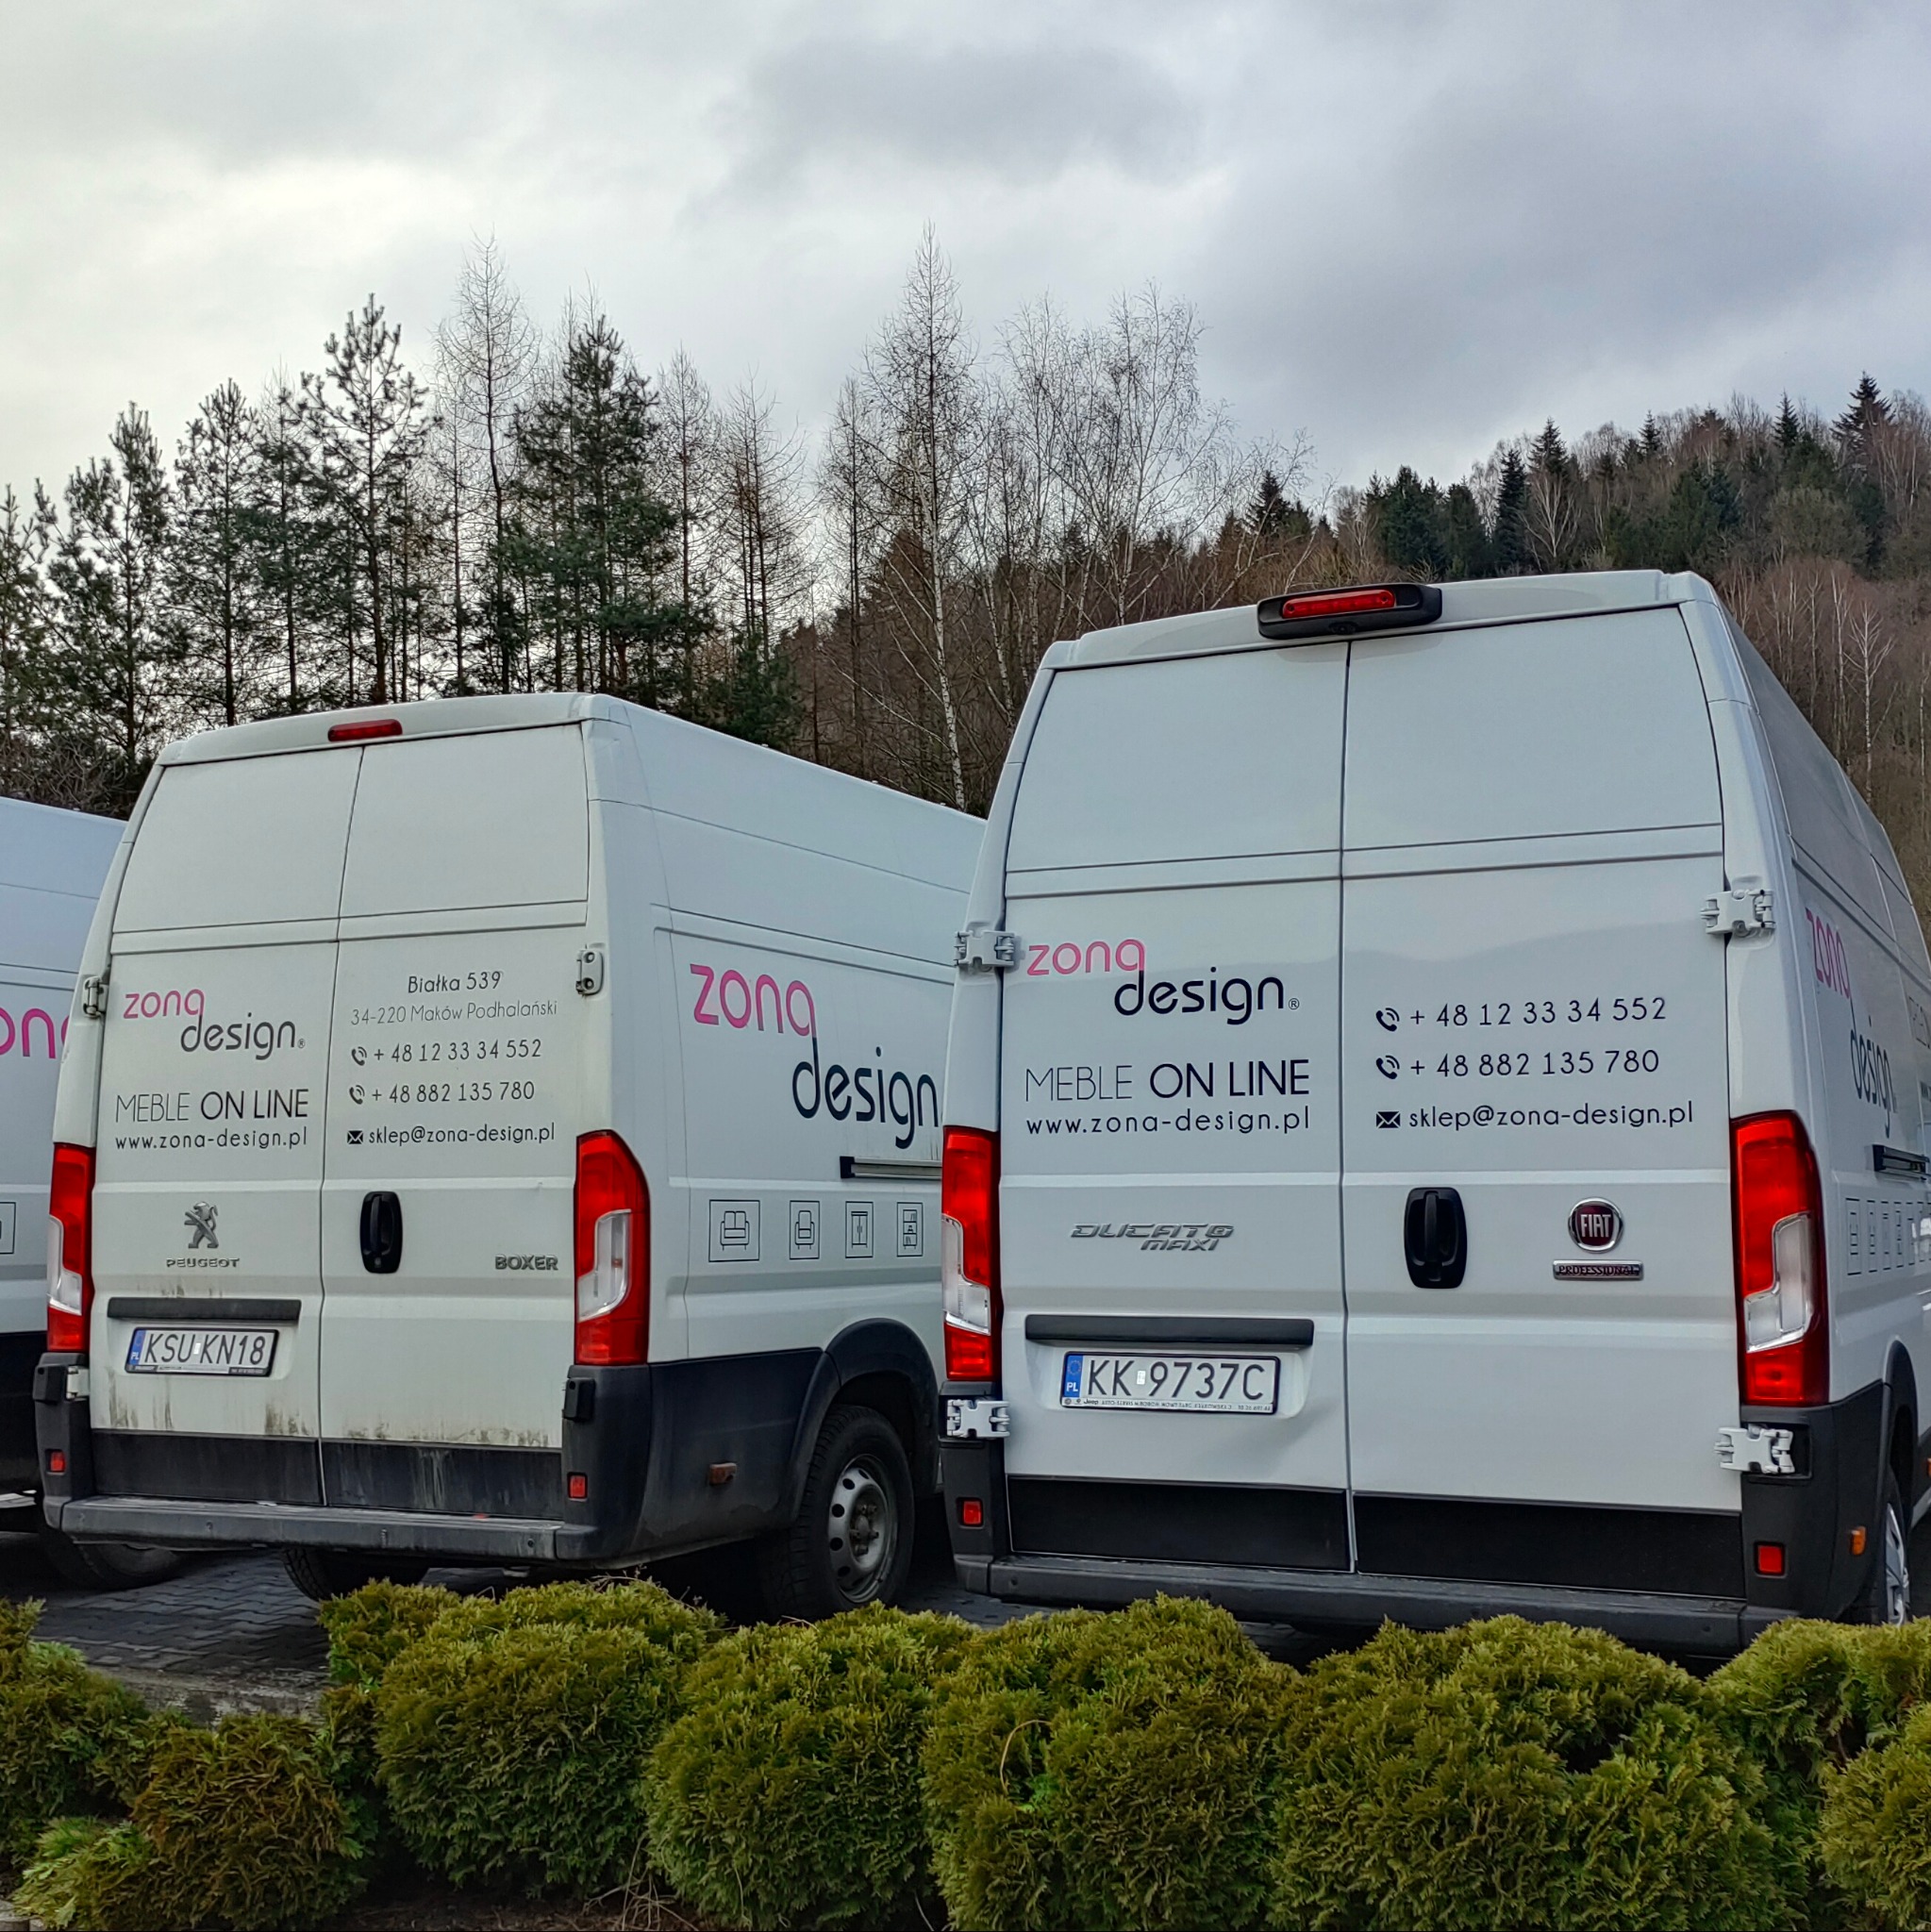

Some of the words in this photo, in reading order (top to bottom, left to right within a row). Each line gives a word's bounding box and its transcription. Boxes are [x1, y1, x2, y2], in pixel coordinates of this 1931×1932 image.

[408, 974, 460, 993] Białka
[466, 971, 501, 990] 539
[350, 1006, 407, 1025] 34-220
[410, 1005, 463, 1022] Maków
[467, 999, 558, 1019] Podhalański
[1437, 1003, 1468, 1027] 48
[1479, 1003, 1510, 1025] 12
[1523, 1001, 1556, 1024] 33
[1567, 997, 1601, 1023] 34
[1612, 996, 1666, 1021] 552
[391, 1042, 412, 1063] 48
[419, 1042, 441, 1061] 12
[447, 1041, 470, 1060] 33
[476, 1040, 499, 1059] 34
[506, 1039, 541, 1058] 552
[1437, 1054, 1469, 1077] 48
[1478, 1053, 1530, 1076] 882
[1542, 1052, 1594, 1074] 135
[1605, 1049, 1659, 1073] 780
[389, 1084, 410, 1104] 48
[416, 1084, 451, 1103] 882
[458, 1082, 492, 1102] 135
[499, 1081, 535, 1100] 780
[1025, 1065, 1132, 1102] MEBLE
[1149, 1062, 1213, 1098] ON
[1229, 1059, 1309, 1096] LINE
[791, 1038, 939, 1149] design
[115, 1092, 191, 1123] MEBLE
[200, 1091, 244, 1120] ON
[254, 1089, 308, 1119] LINE
[1409, 1100, 1692, 1131] sklep@zona-design.pl
[1026, 1105, 1309, 1134] www.zona-design.pl
[115, 1126, 307, 1150] www.zona-design.pl
[369, 1122, 555, 1146] sklep@zona-design.pl
[1071, 1223, 1235, 1238] DUCATO
[1580, 1214, 1611, 1238] FIAT
[1140, 1239, 1220, 1251] MAXI
[166, 1257, 241, 1269] PEUGEOT
[494, 1254, 559, 1272] BOXER
[1558, 1265, 1640, 1276] PROFESSIONAL
[144, 1333, 196, 1363] KSU
[200, 1334, 266, 1365] KN18
[1066, 1382, 1078, 1392] PL
[1088, 1359, 1135, 1396] KK
[1149, 1360, 1265, 1401] 9737C
